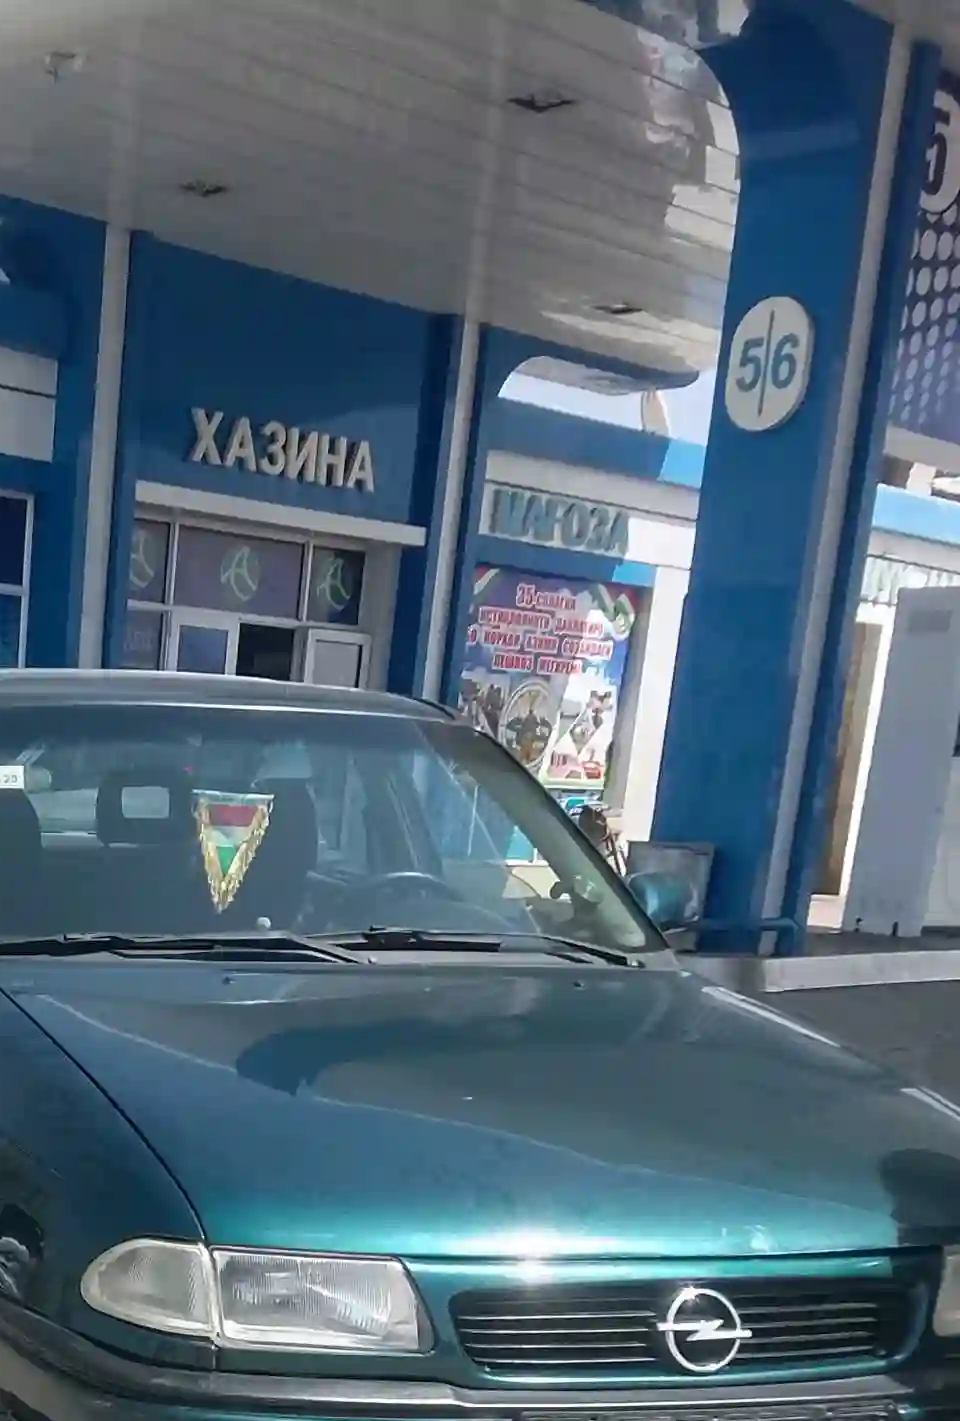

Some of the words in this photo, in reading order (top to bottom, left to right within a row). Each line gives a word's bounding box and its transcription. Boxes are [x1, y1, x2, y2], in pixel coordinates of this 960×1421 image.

[736, 338, 763, 391] 5
[771, 333, 799, 389] 6
[191, 407, 375, 492] ХАЗИНА
